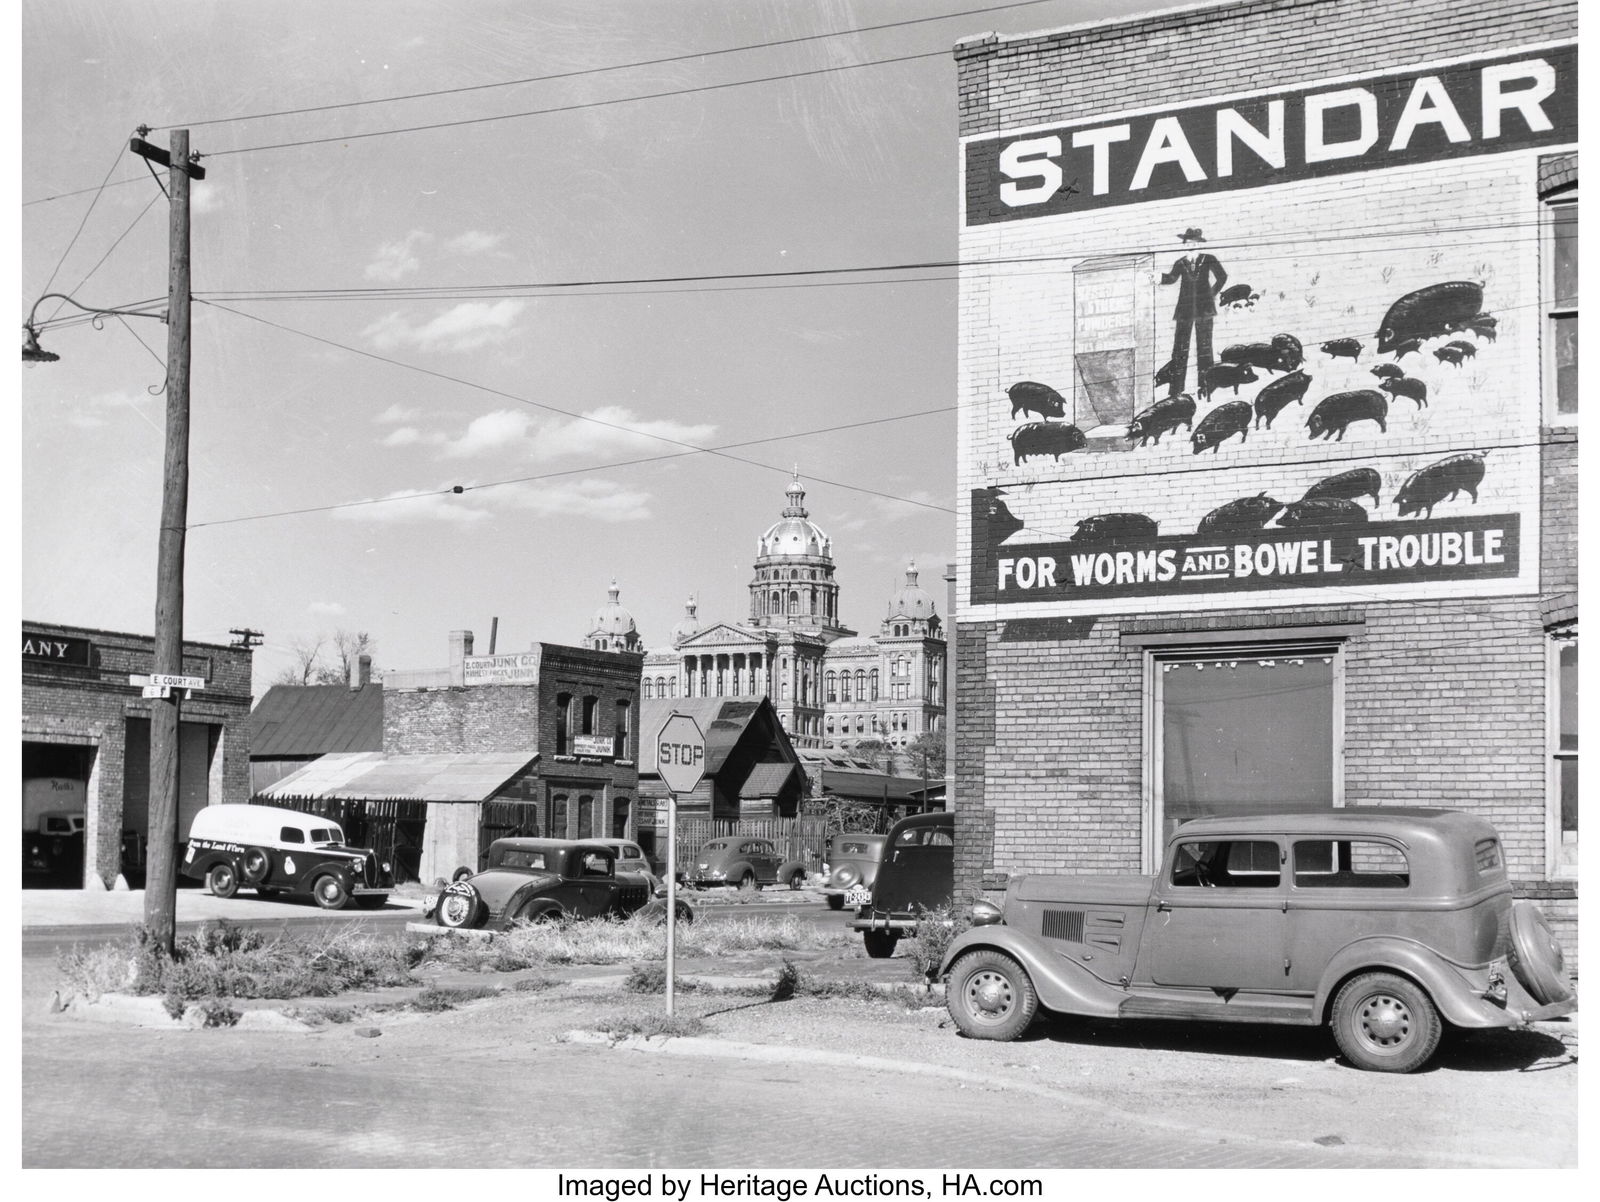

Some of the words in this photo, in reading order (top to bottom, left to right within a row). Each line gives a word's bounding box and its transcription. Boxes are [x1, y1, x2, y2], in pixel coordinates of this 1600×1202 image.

[1000, 58, 1556, 208] STANDAR
[998, 557, 1057, 591] FOR
[1070, 549, 1177, 586] WORMS
[1181, 553, 1230, 572] AND
[1234, 540, 1344, 578] BOWEL
[1358, 529, 1505, 572] TROUBLE
[471, 661, 491, 669] COURT
[491, 656, 518, 668] JUNK
[508, 668, 534, 679] JUNK
[153, 675, 159, 685] E
[163, 676, 187, 687] COURT
[660, 742, 704, 767] STOP
[211, 841, 226, 851] Land
